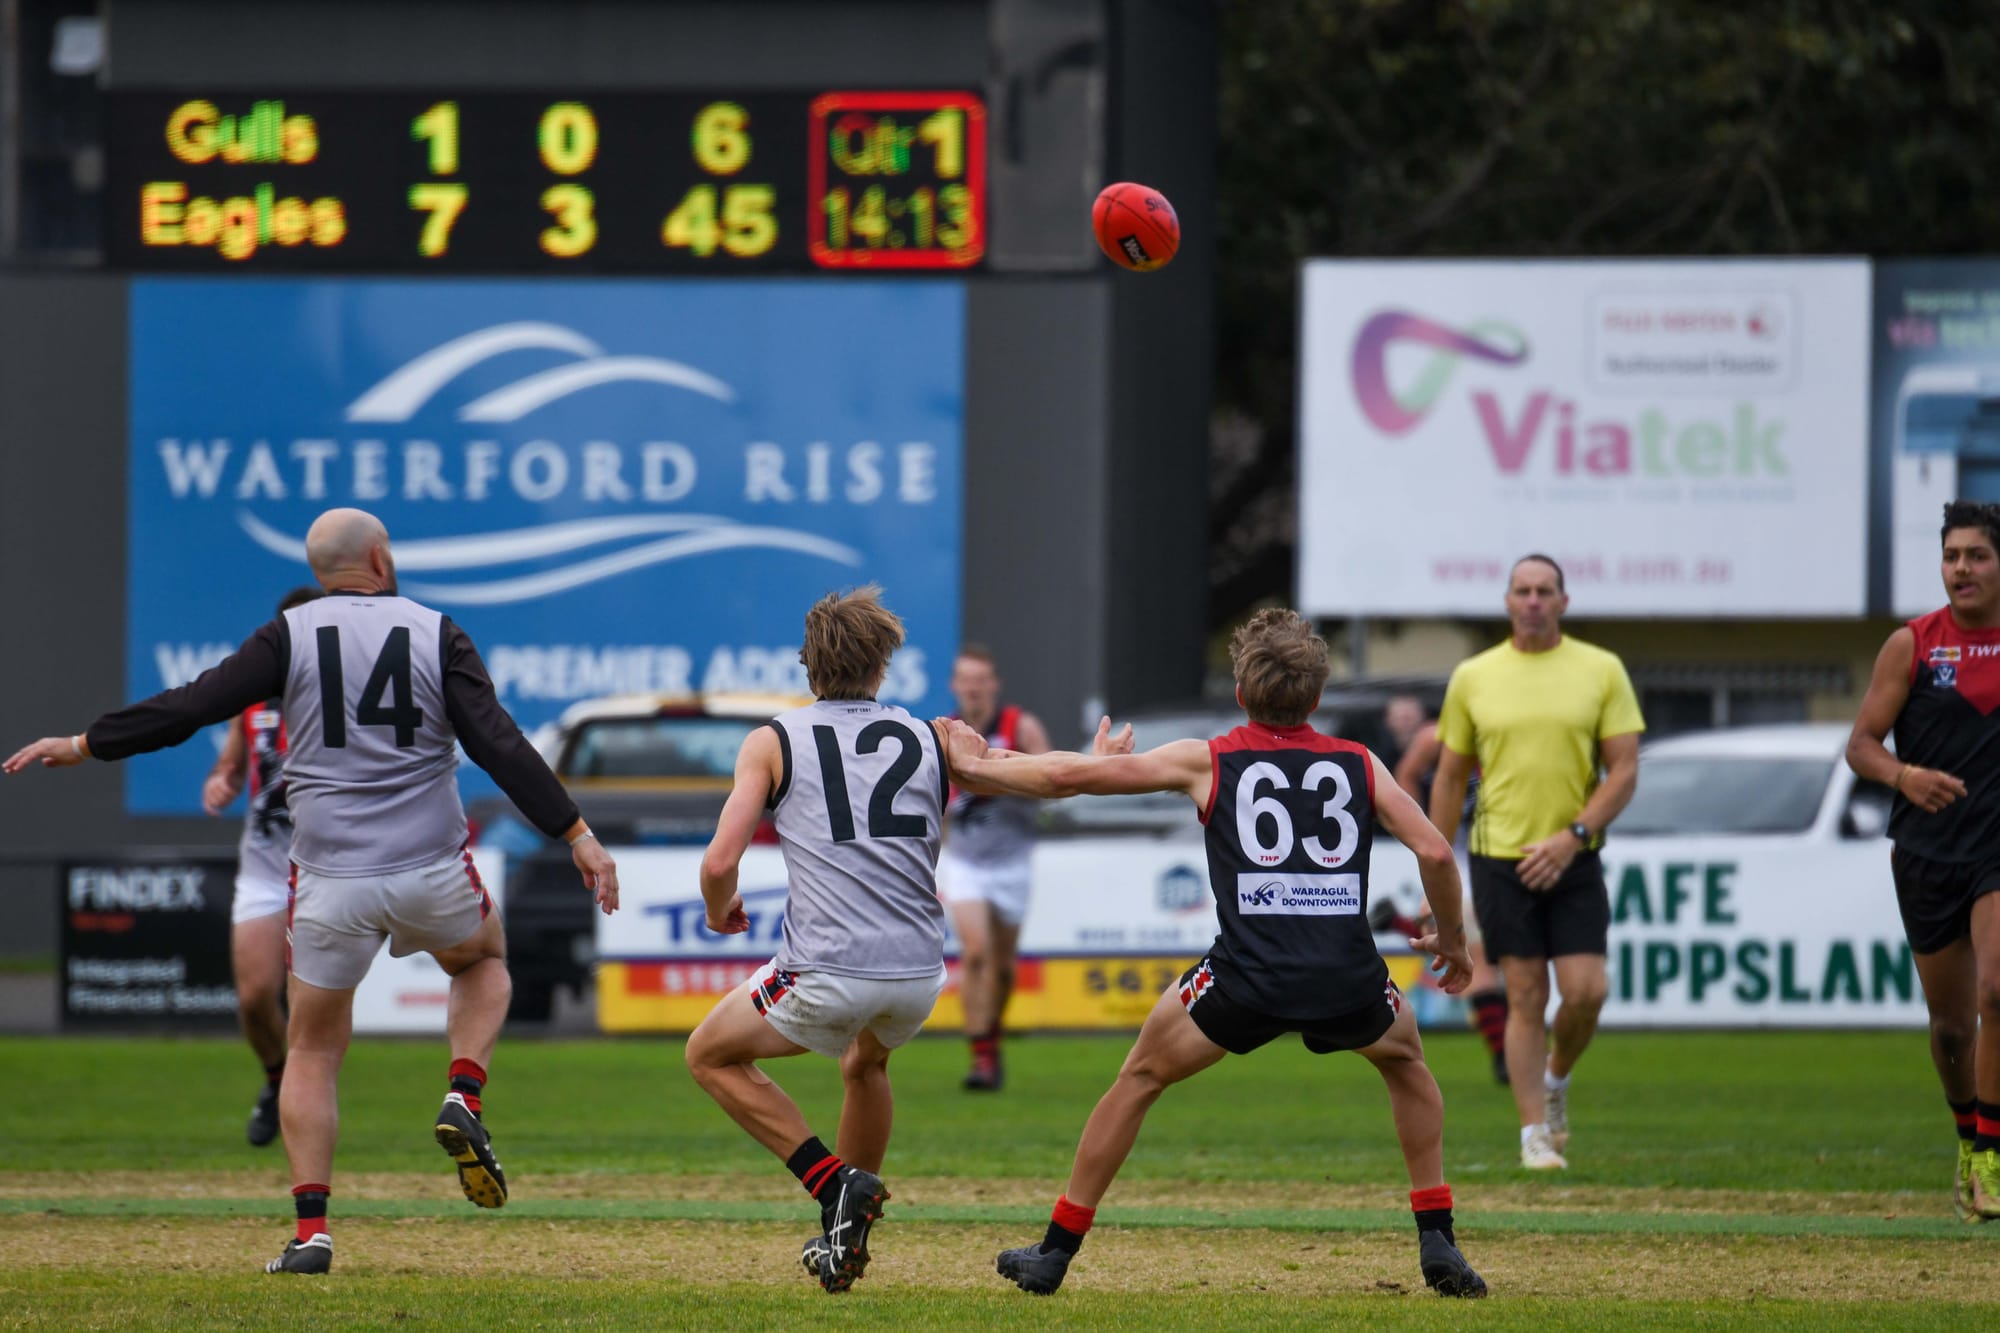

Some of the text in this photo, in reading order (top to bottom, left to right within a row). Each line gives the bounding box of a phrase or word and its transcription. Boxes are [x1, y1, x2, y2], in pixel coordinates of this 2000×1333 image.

[166, 100, 752, 175] Gulls 1 0 6
[918, 105, 965, 179] 1
[140, 182, 778, 260] Eagles 7 3 45
[821, 184, 975, 249] 14:13
[1472, 391, 1792, 479] Viatek
[158, 438, 938, 501] WATERFORD RISE
[315, 625, 424, 749] 14
[486, 645, 930, 702] PREMIER ADDS
[812, 719, 928, 843] 12
[1234, 760, 1360, 868] 63
[68, 868, 206, 911] FINDEX
[1291, 886, 1350, 896] WARRAGUL
[1321, 856, 1342, 864] TWP
[1281, 897, 1359, 907] DOWNTOWNER
[1604, 862, 1739, 927] AFE
[1606, 941, 1924, 1004] IPPSLAN
